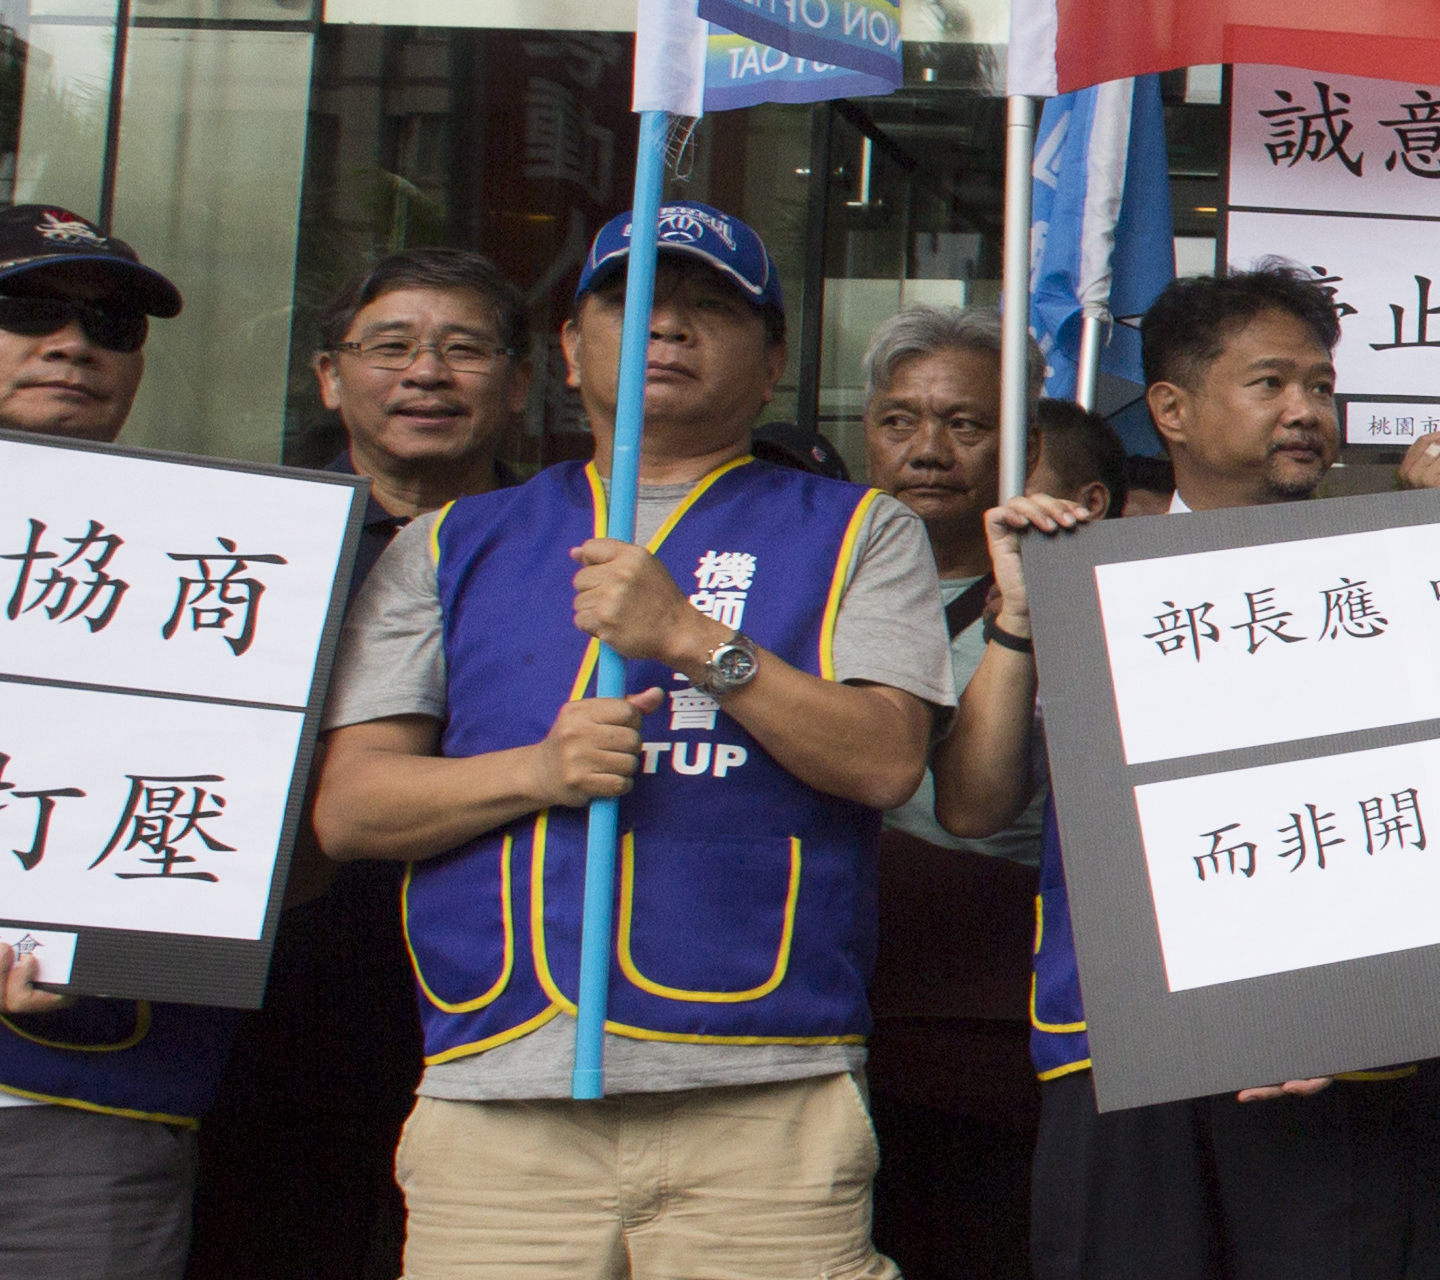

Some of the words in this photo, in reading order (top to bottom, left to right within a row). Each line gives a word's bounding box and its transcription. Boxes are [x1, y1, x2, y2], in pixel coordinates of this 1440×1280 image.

[669, 550, 757, 731] 機師會
[641, 741, 749, 778] TUP
